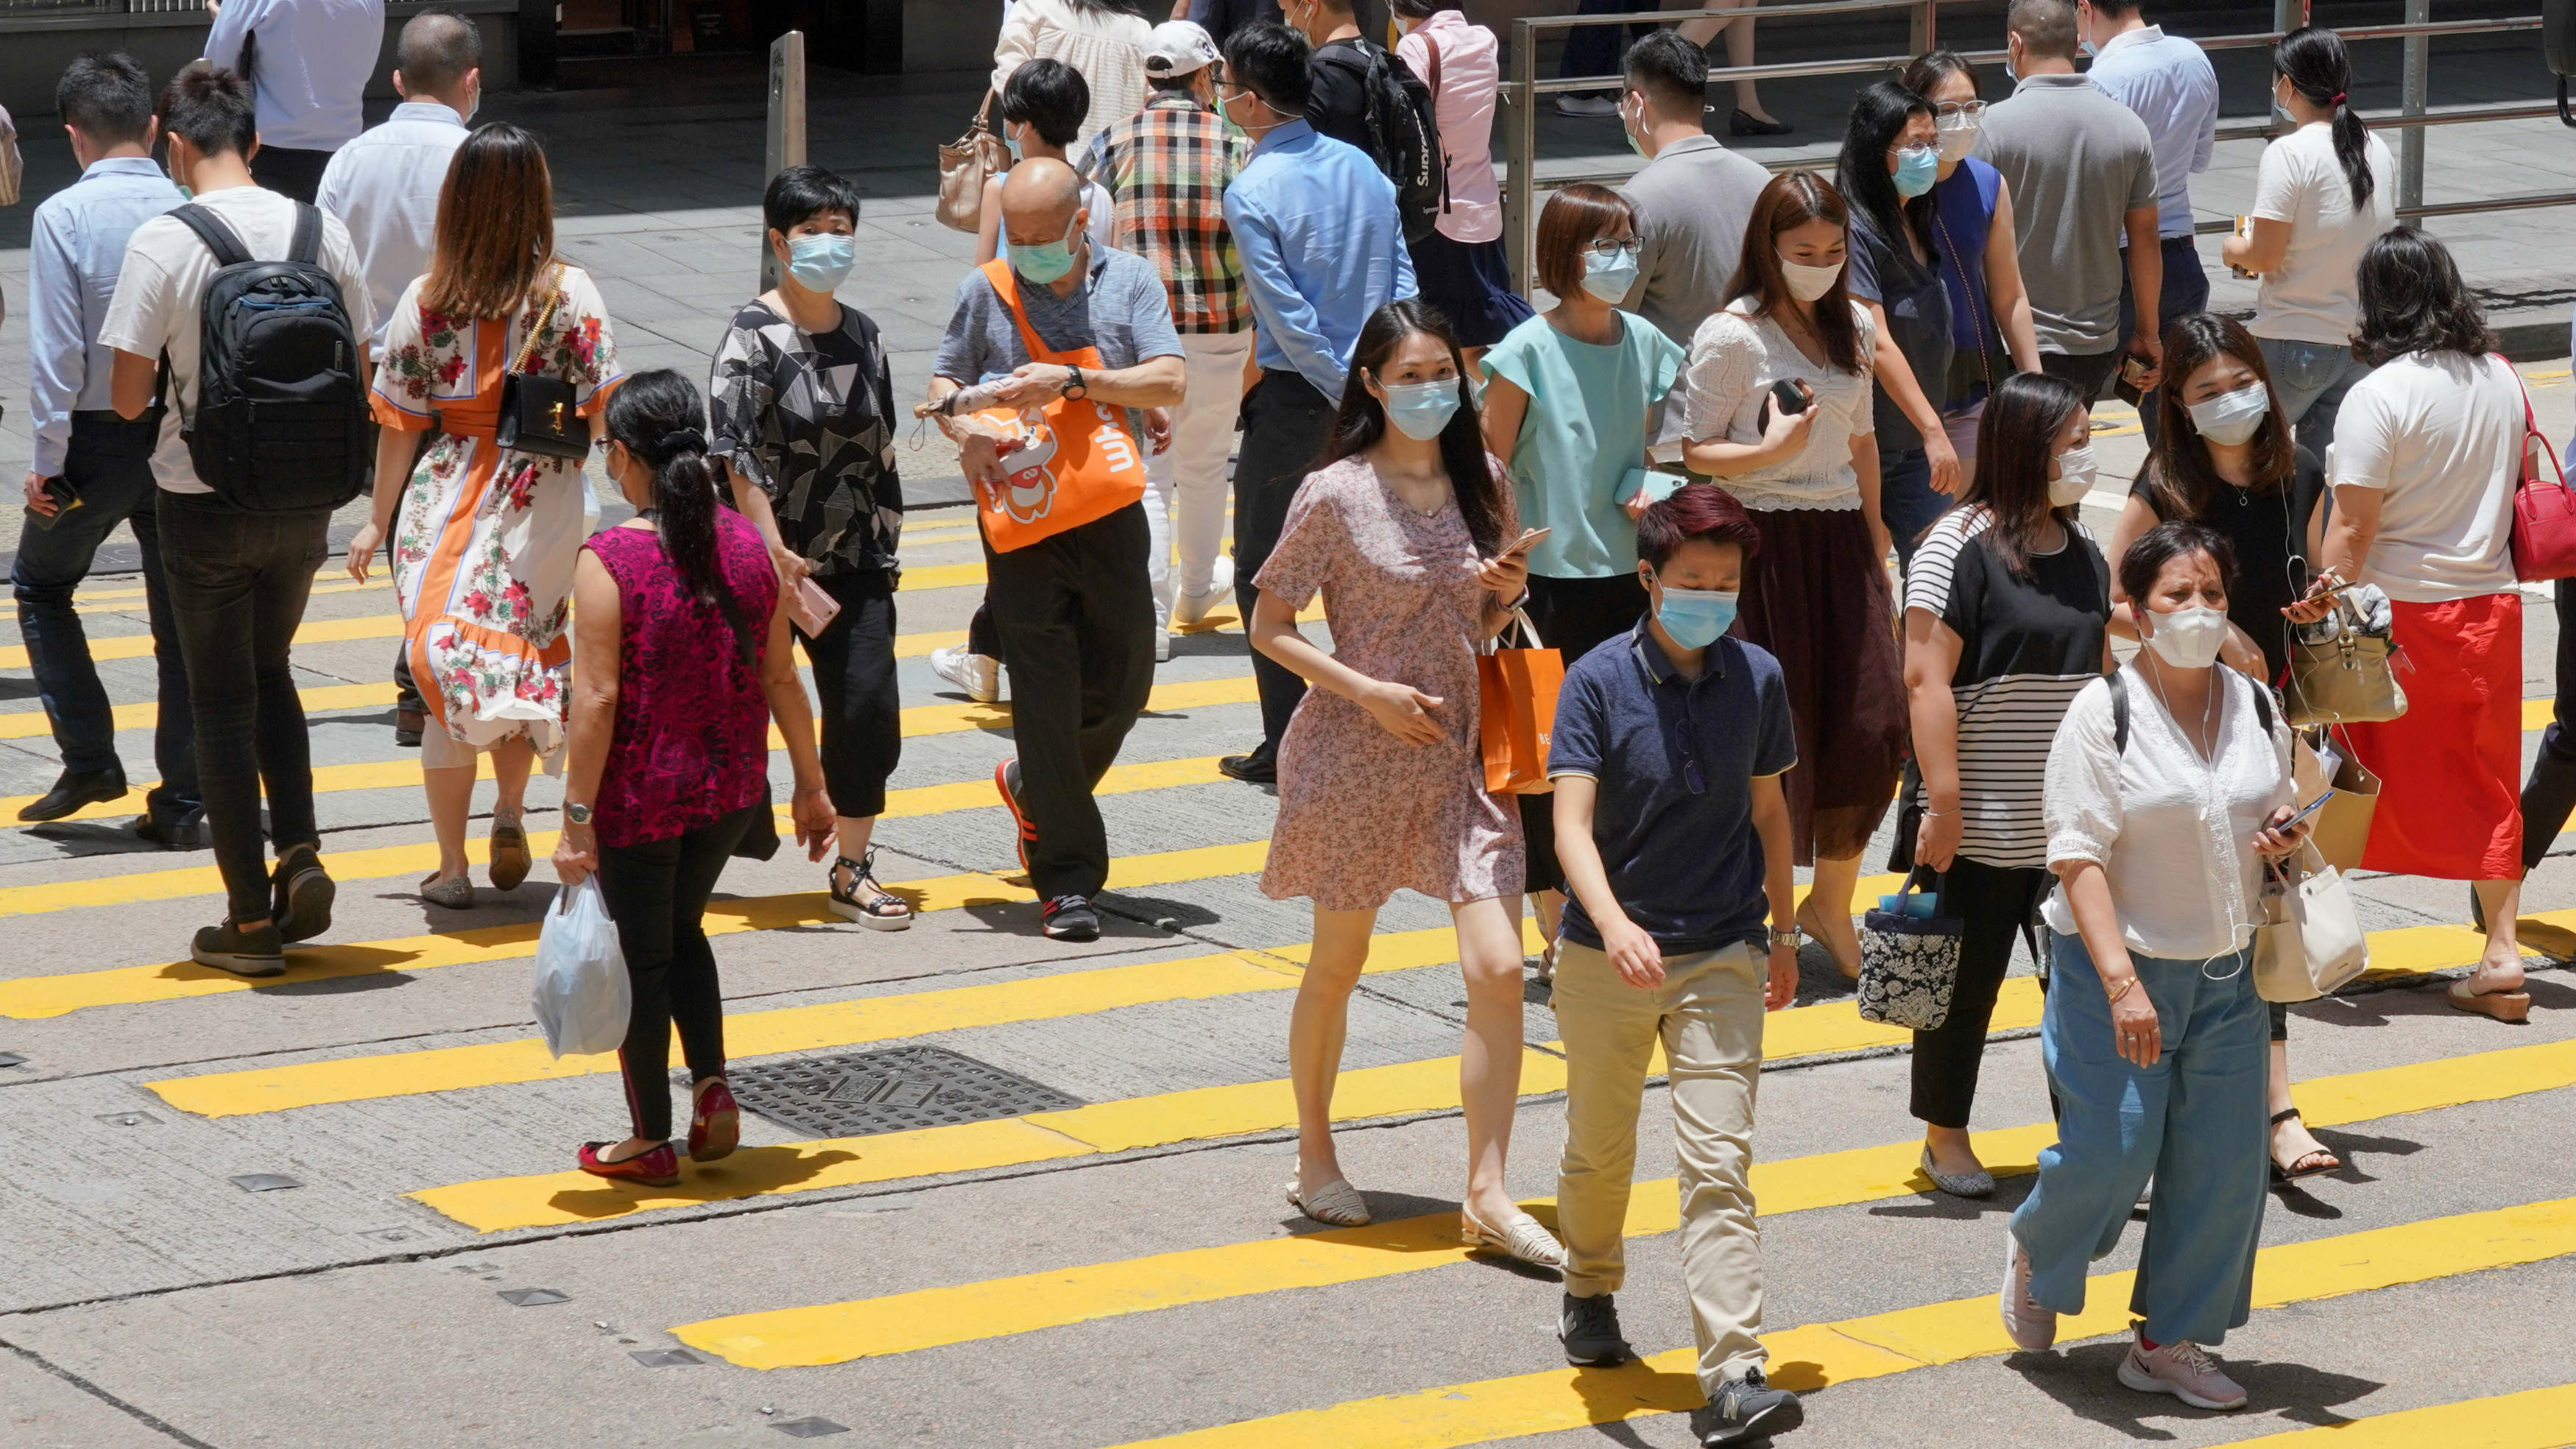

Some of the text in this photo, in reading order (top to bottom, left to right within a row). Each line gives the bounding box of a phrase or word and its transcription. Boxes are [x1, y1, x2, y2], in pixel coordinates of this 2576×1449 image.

[1202, 41, 1214, 59] 3
[1414, 108, 1429, 187] Supre
[1723, 1392, 1741, 1420] N
